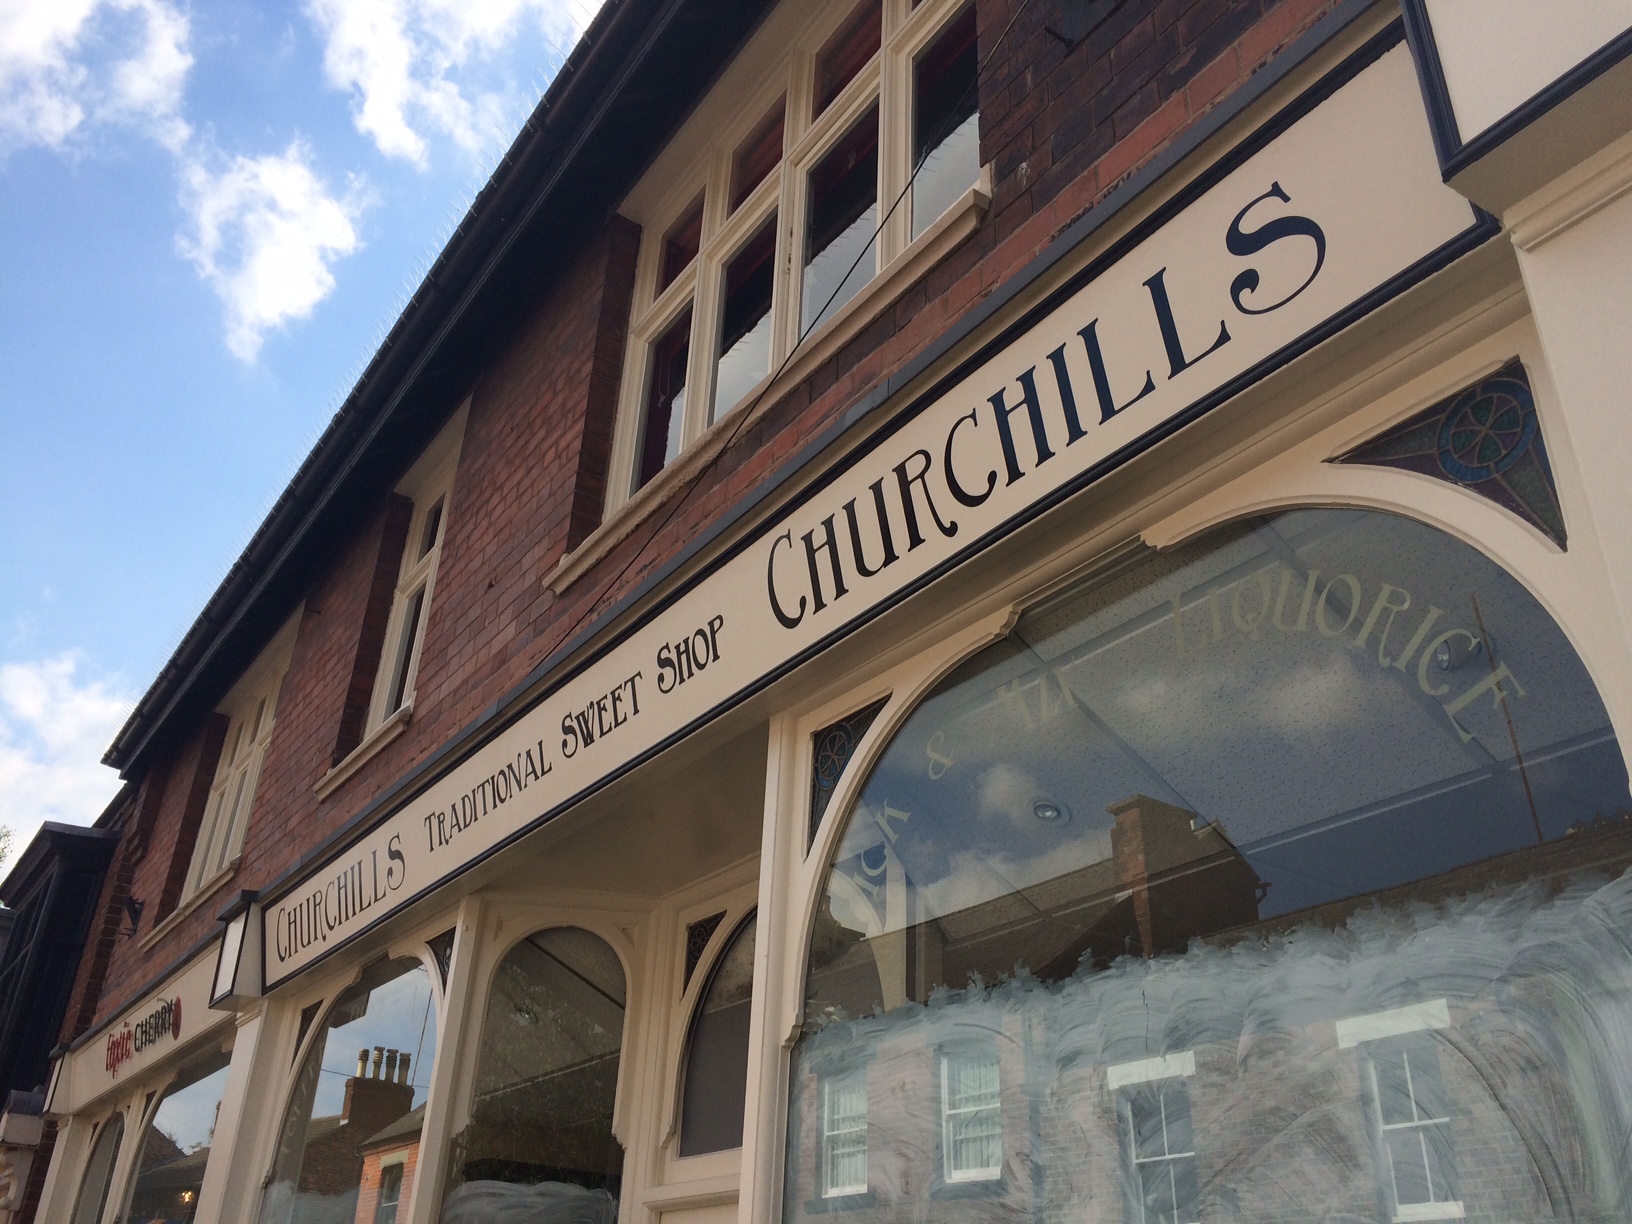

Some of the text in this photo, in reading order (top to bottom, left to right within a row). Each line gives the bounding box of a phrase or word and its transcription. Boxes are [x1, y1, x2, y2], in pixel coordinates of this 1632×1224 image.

[276, 180, 1327, 963] CHURCHILLS TRADITIONAL SWEET SHOP CHURCHILLS
[1167, 569, 1527, 744] LIQUORICE
[133, 998, 175, 1053] CHERRY
